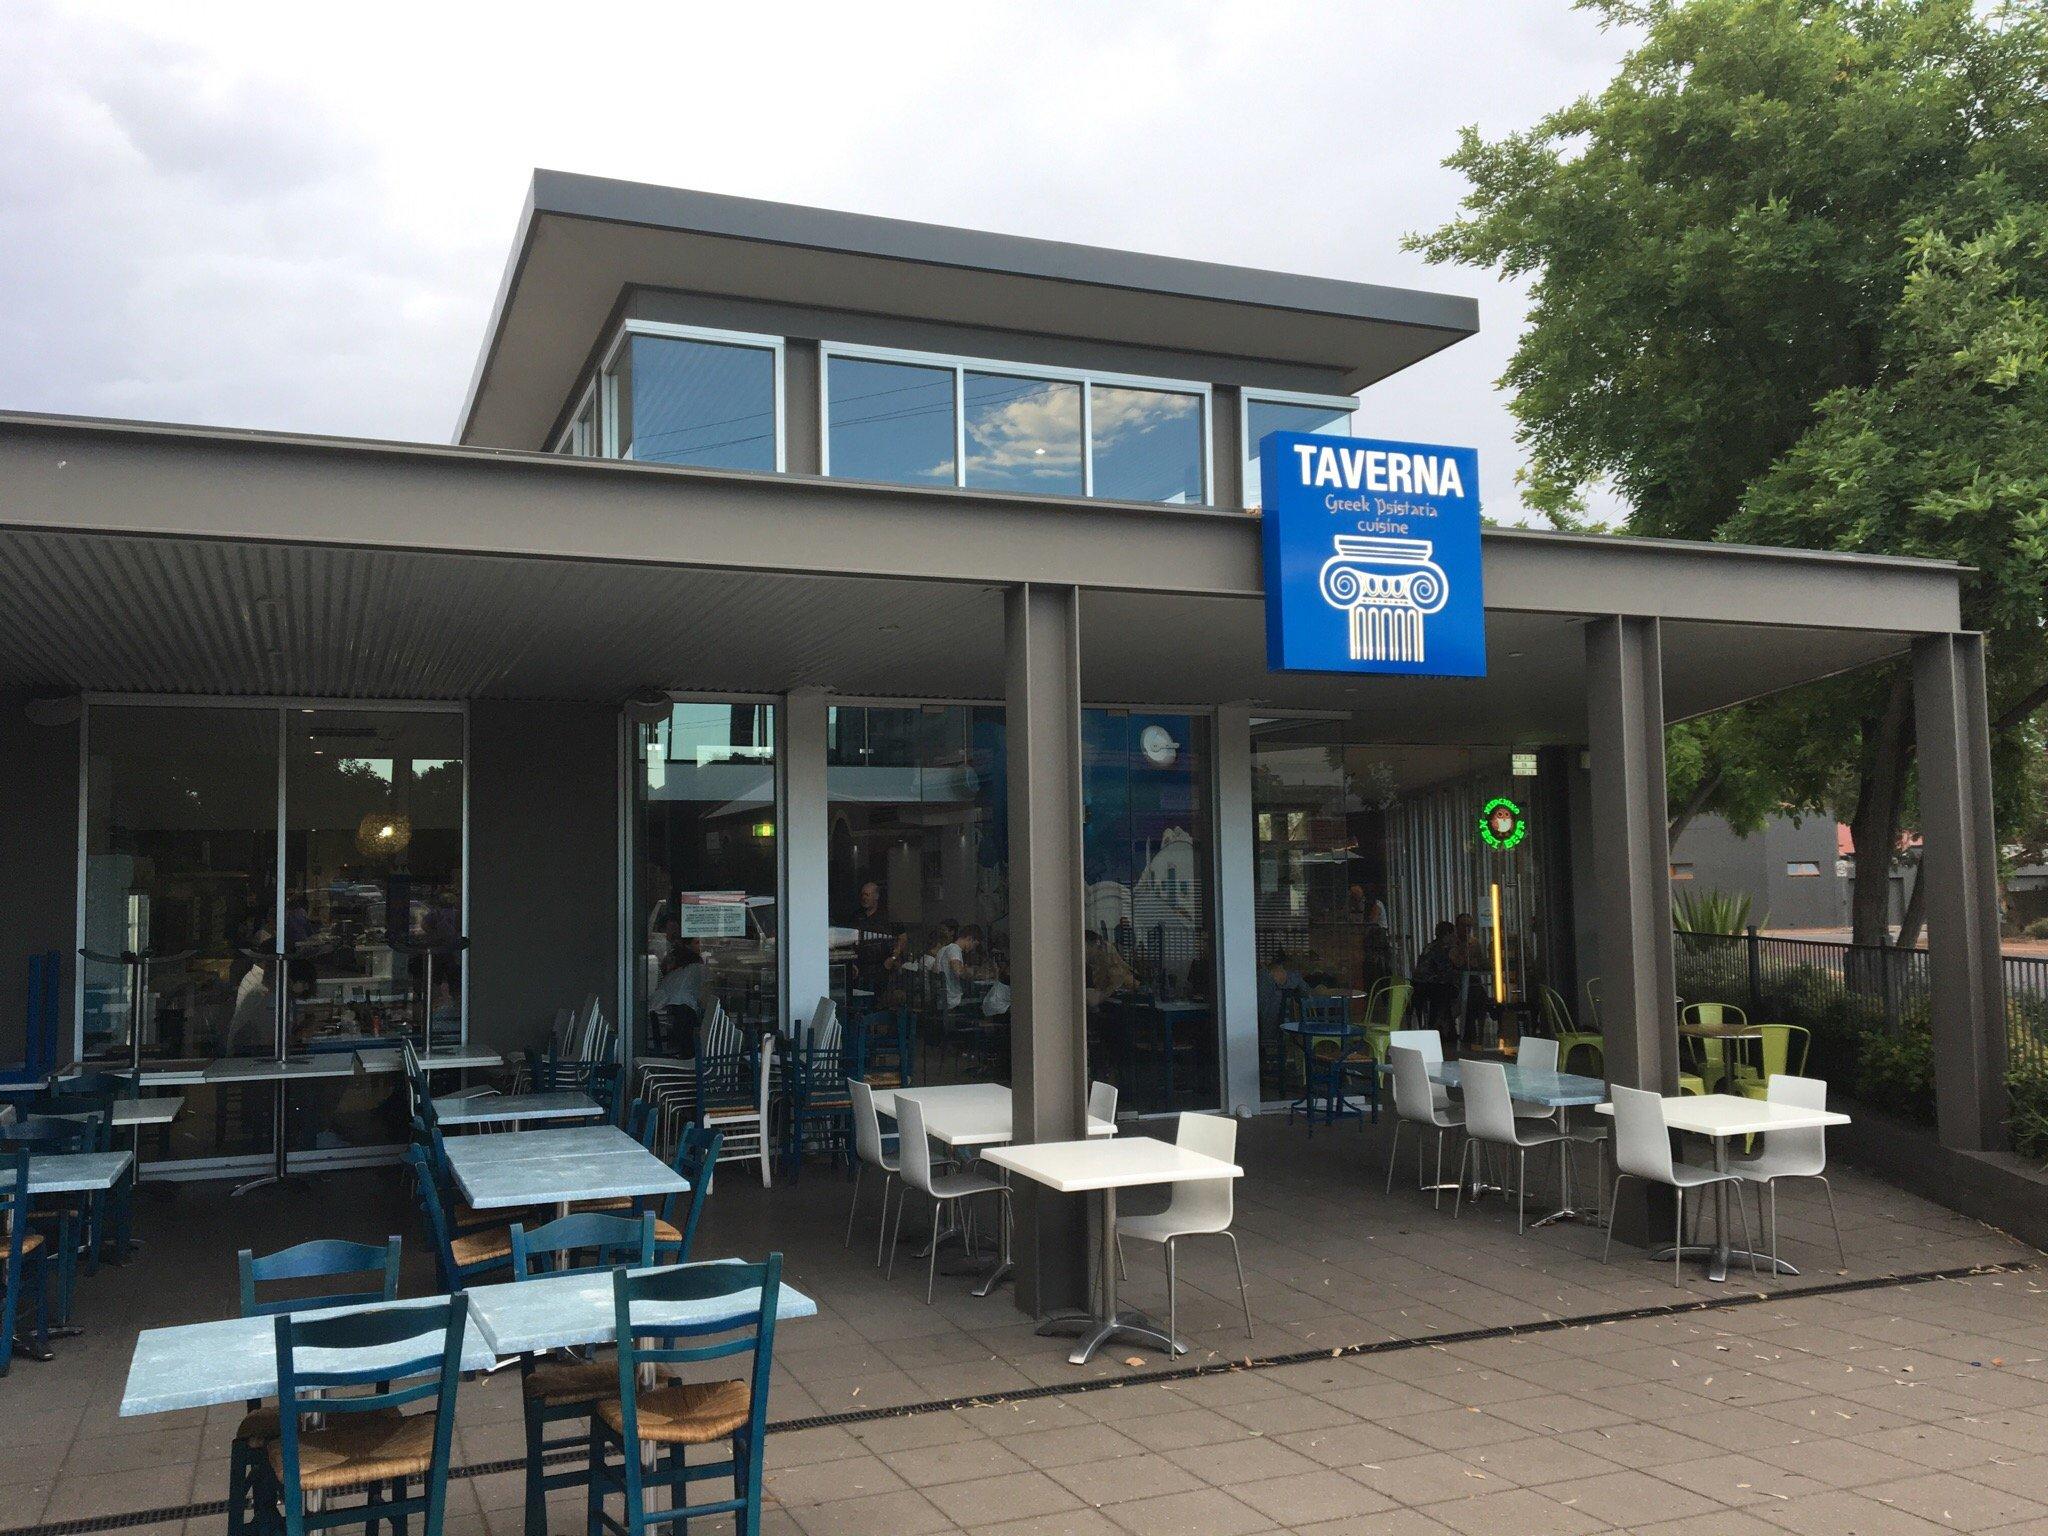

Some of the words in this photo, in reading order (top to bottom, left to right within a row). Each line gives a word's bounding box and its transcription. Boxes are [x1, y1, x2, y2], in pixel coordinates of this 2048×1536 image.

[1293, 444, 1465, 498] TAVERNA
[1325, 493, 1370, 514] Greek
[1374, 497, 1438, 517] Psistaria
[1357, 517, 1409, 534] cuisine
[1479, 819, 1501, 849] NEST
[1503, 820, 1525, 849] BEER
